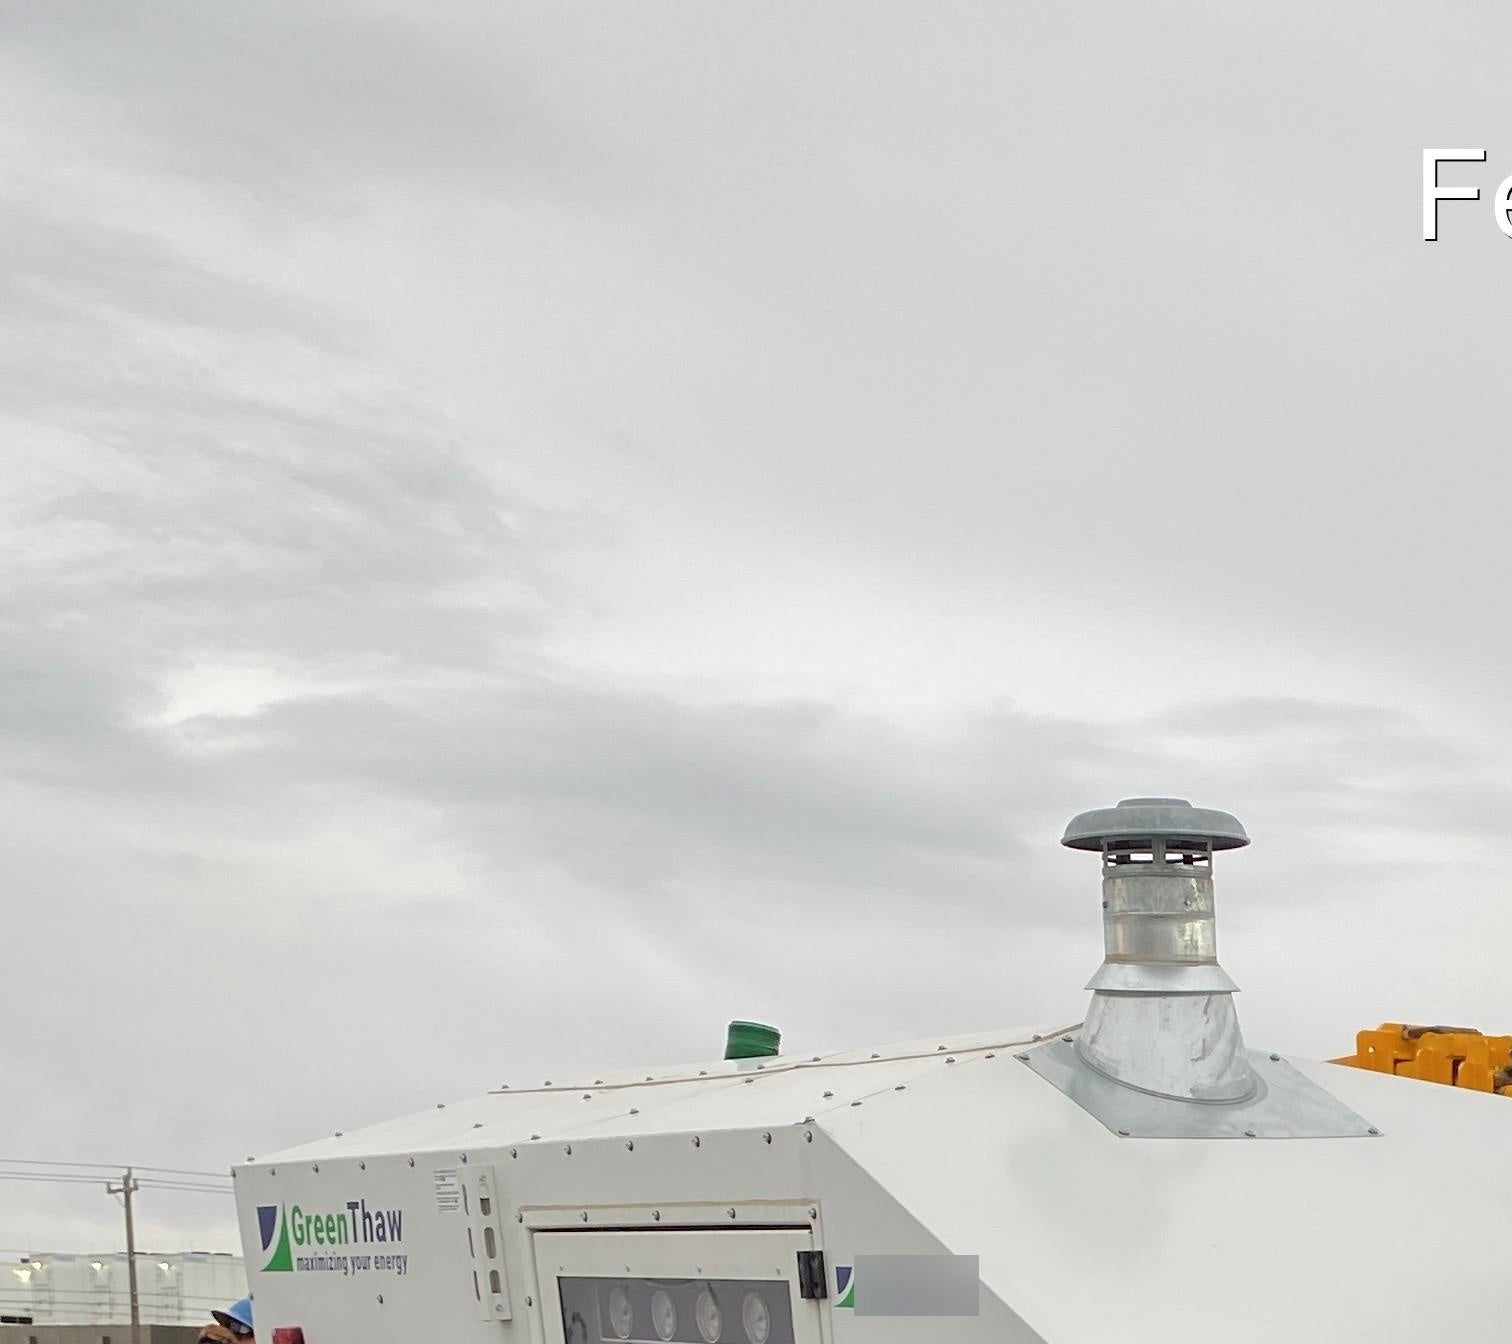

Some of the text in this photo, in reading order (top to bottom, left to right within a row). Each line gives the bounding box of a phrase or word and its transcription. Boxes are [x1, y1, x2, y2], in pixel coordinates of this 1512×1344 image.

[291, 1199, 402, 1246] GreenThaw
[296, 1251, 408, 1276] maximizing your energy
